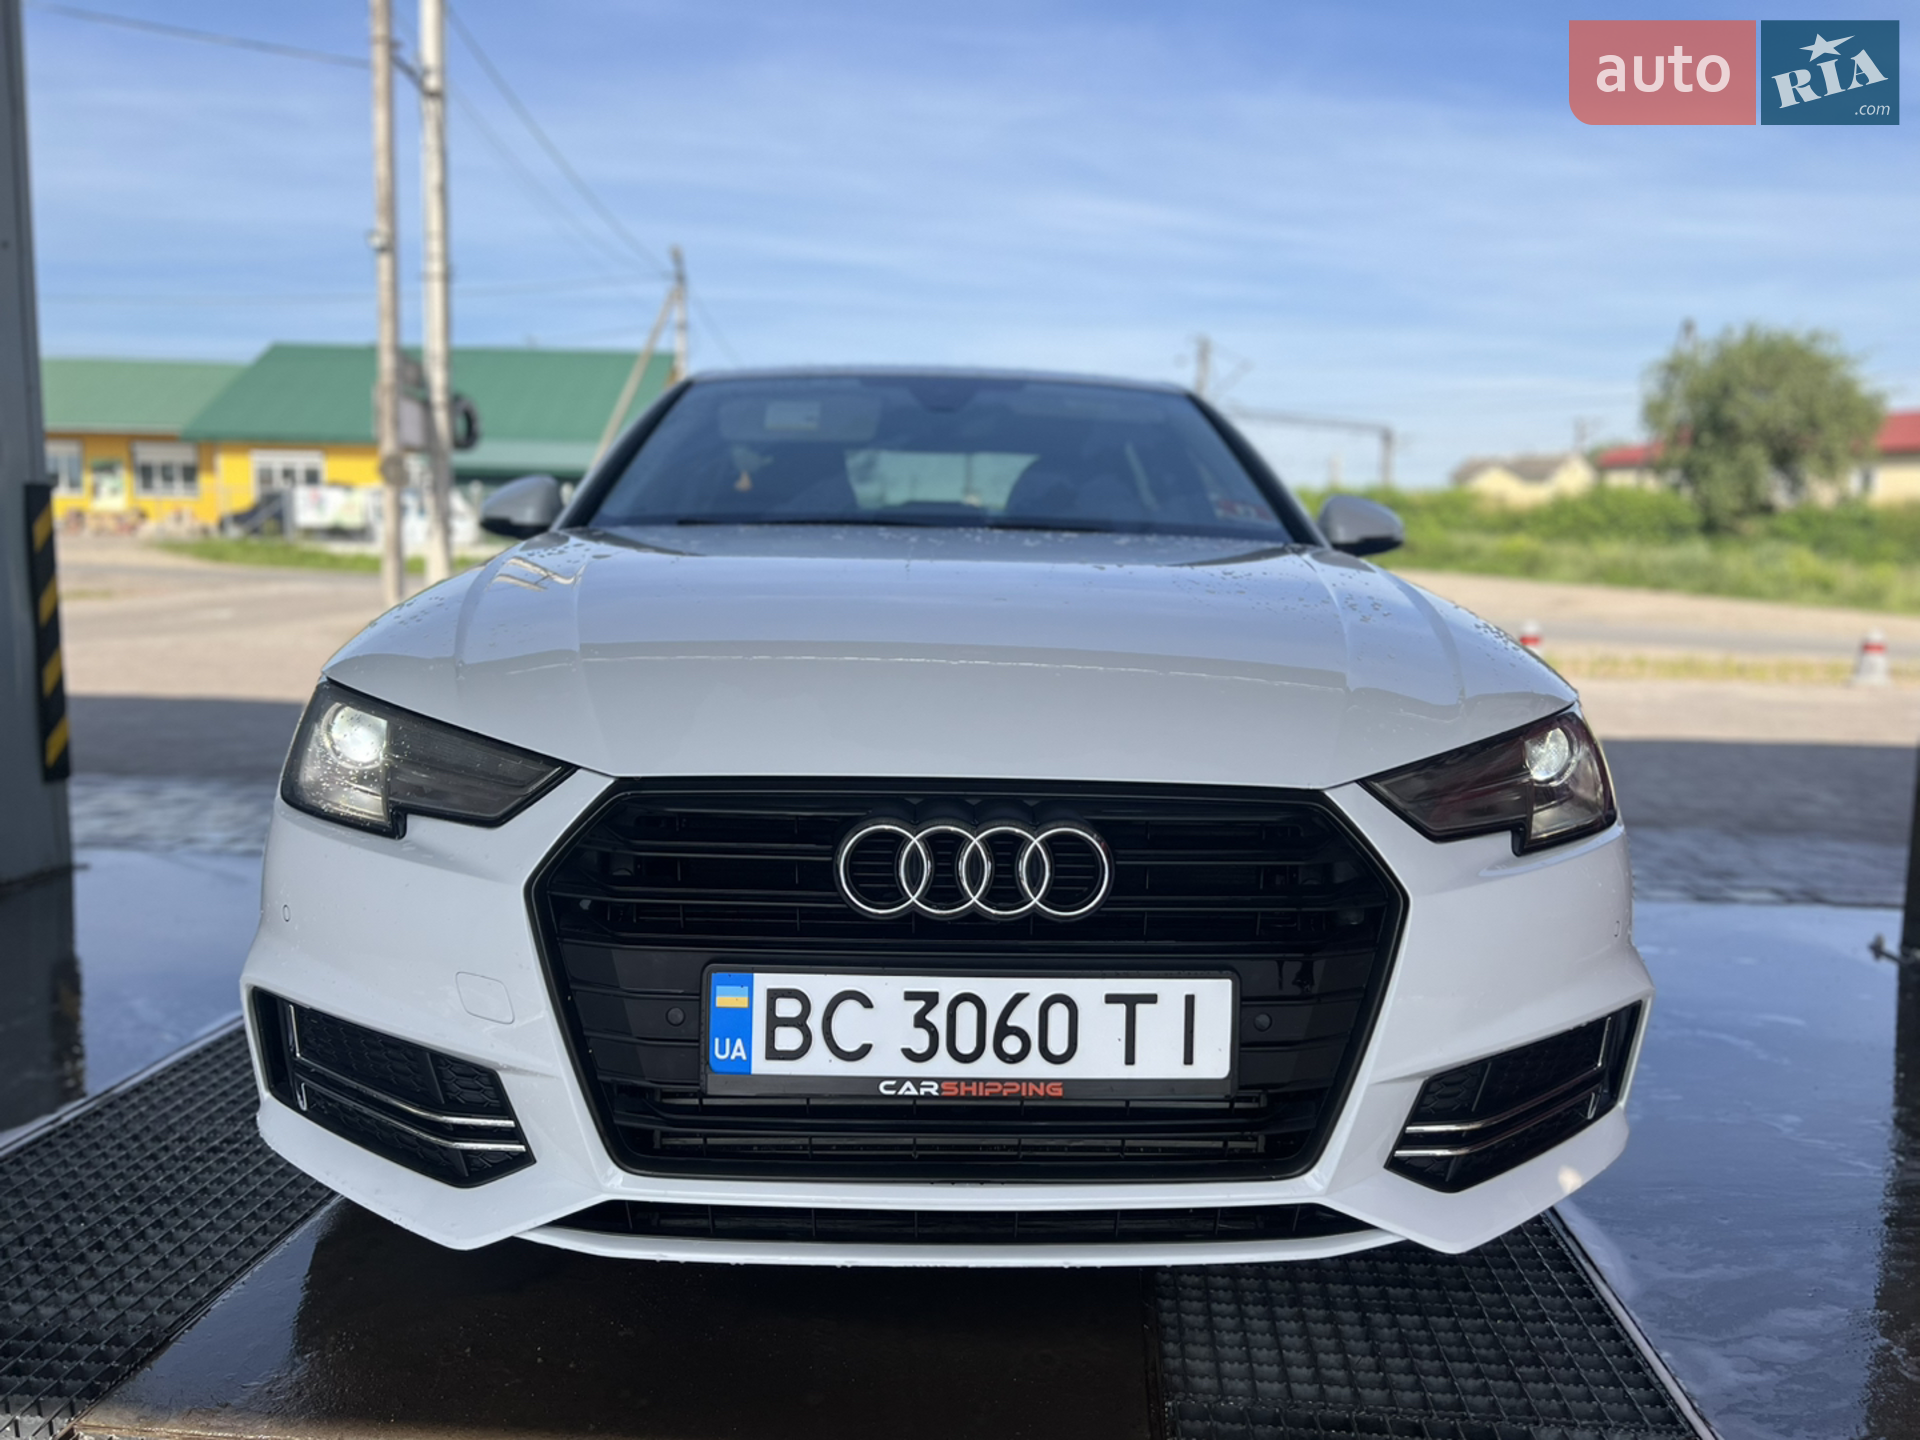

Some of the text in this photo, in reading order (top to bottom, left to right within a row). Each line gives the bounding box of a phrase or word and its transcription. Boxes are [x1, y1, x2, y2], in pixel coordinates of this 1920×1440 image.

[765, 987, 1196, 1066] BC 3060 TI
[714, 1037, 747, 1061] UA
[879, 1079, 1064, 1097] CARSHIPPING
